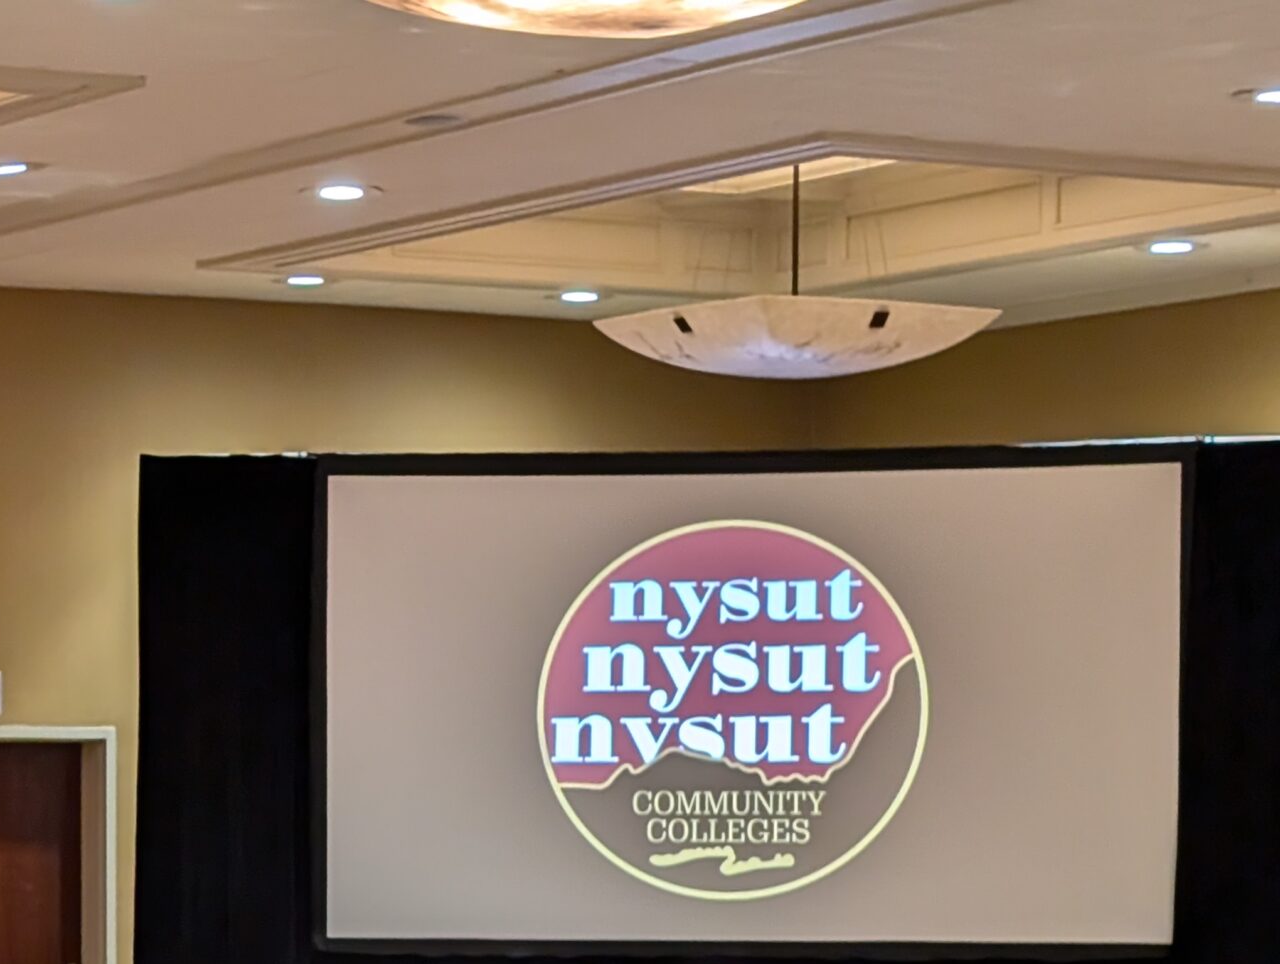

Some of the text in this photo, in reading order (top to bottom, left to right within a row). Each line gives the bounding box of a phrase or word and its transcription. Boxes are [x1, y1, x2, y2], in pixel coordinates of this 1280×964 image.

[609, 569, 863, 639] nysut
[582, 632, 881, 712] nysut
[632, 790, 827, 816] COMMUNITY
[646, 818, 811, 844] COLLEGES
